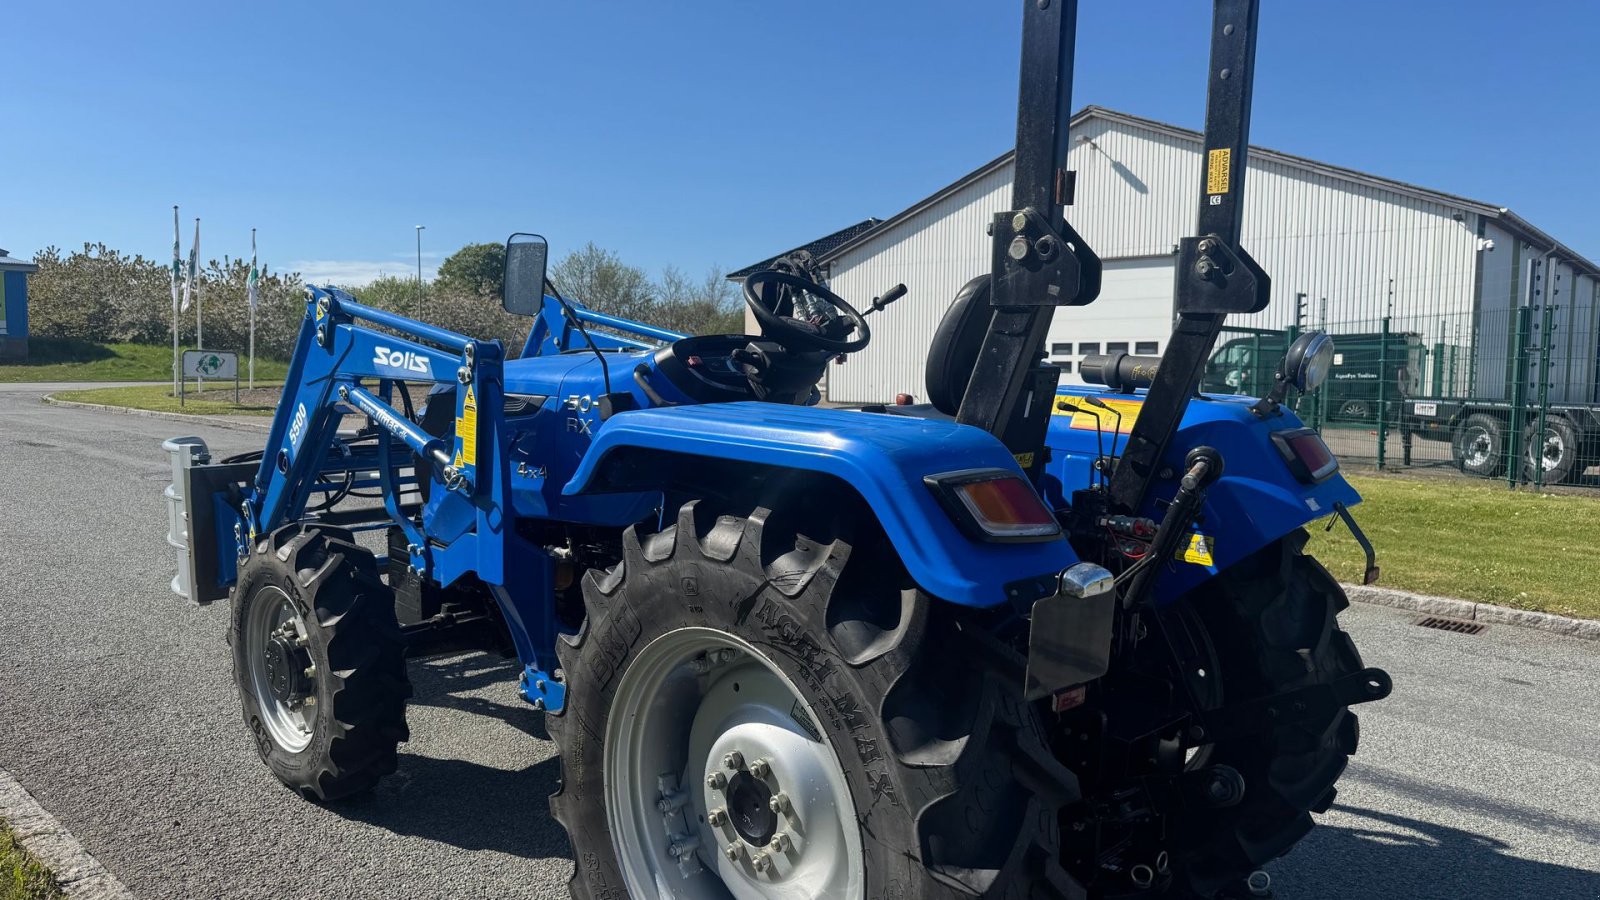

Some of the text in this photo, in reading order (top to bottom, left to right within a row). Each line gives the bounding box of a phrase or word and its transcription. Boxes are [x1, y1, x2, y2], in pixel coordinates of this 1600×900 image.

[1220, 150, 1229, 191] ADVARSEL
[288, 402, 307, 446] 5500
[567, 418, 593, 435] RX
[516, 461, 548, 479] 4x4
